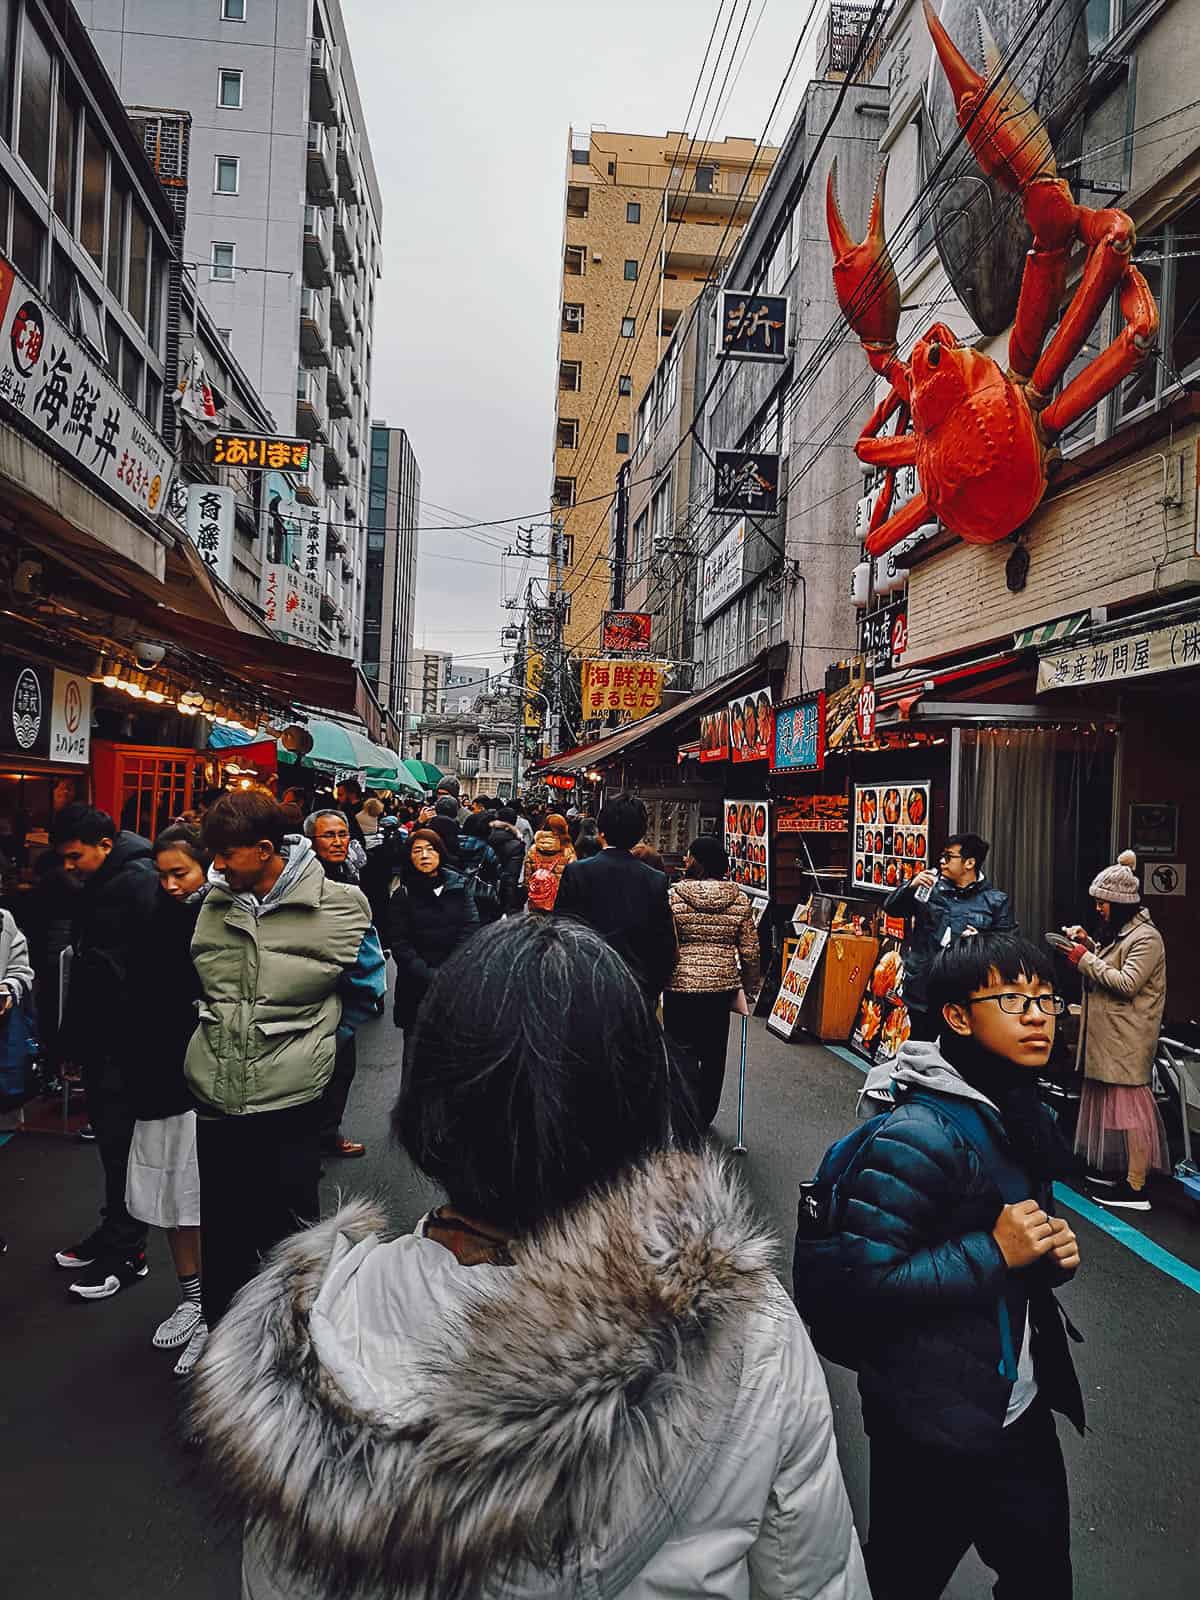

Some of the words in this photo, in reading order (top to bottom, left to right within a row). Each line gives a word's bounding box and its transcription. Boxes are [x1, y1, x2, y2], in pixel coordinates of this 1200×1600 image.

[34, 343, 121, 477] 海鮮丼
[116, 448, 150, 500] まるきた
[590, 666, 657, 689] 海鮮丼
[1049, 638, 1149, 683] 海産物問屋
[590, 692, 656, 708] まるきた
[858, 691, 875, 716] 120
